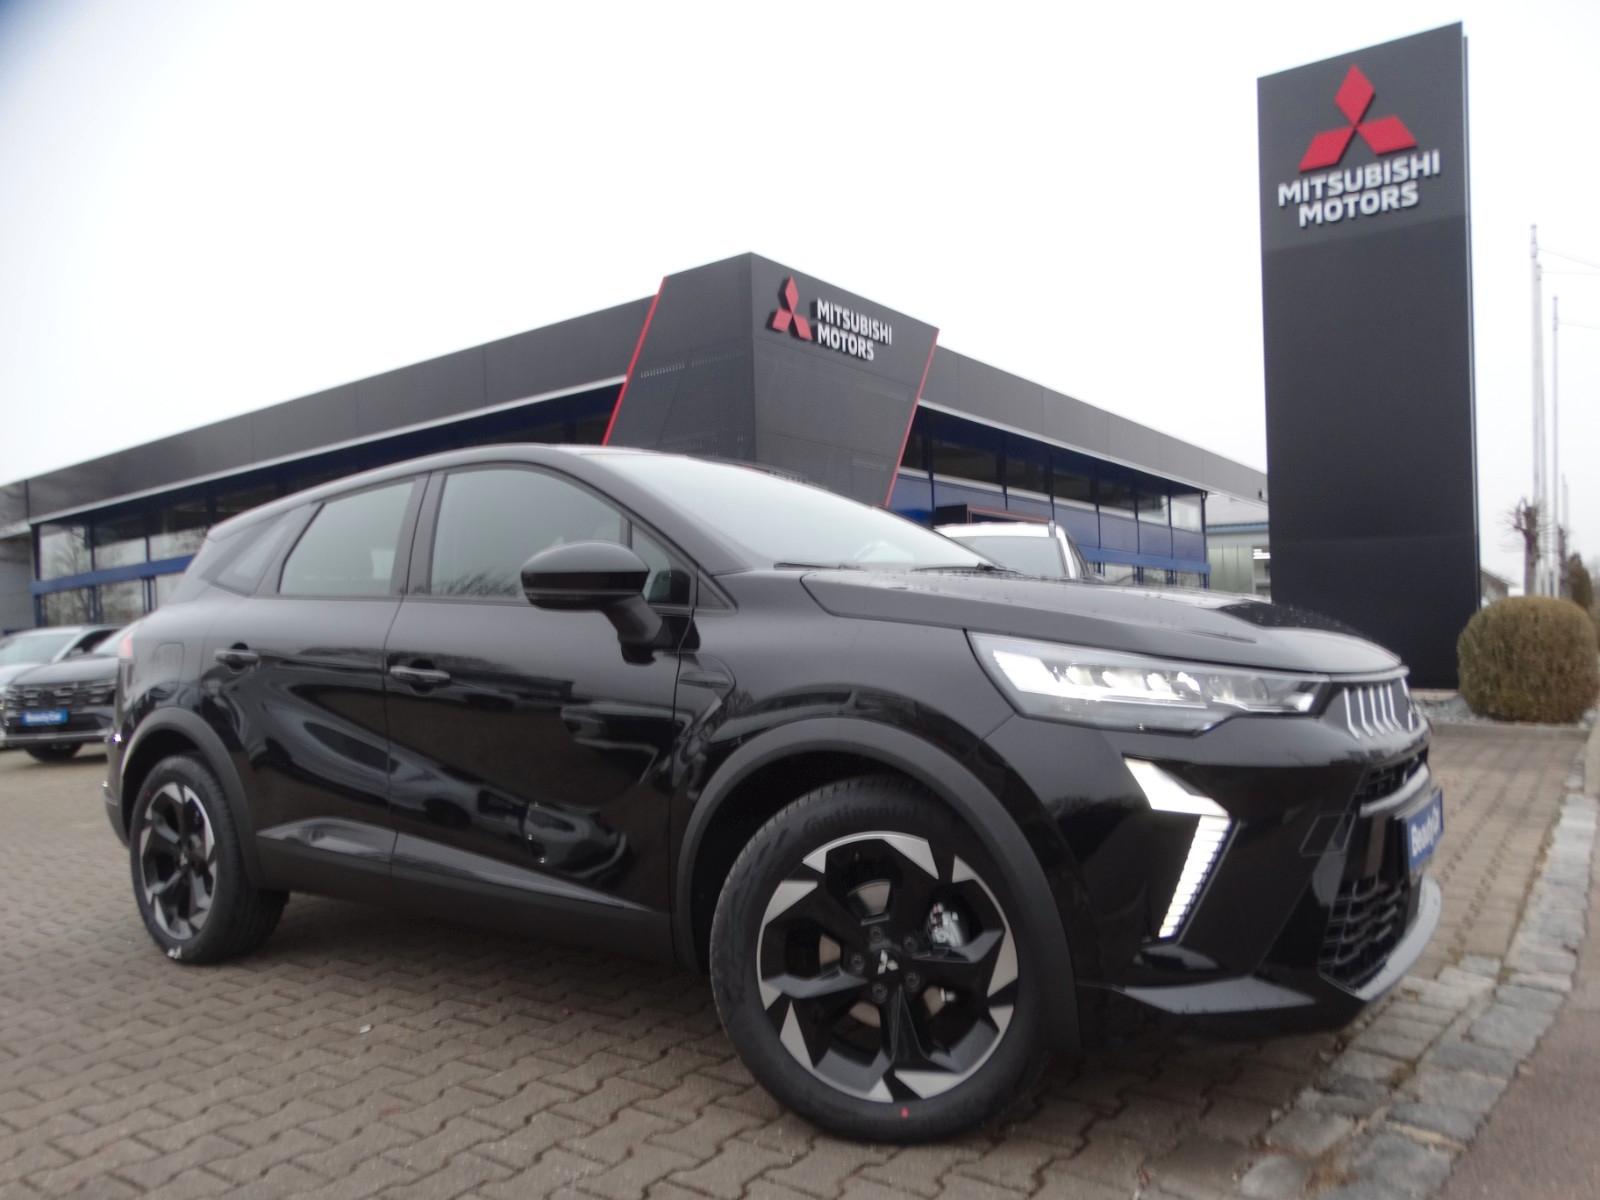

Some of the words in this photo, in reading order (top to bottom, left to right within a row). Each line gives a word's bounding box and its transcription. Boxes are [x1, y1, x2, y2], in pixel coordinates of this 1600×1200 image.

[1278, 150, 1440, 207] MITSUBISHI
[1300, 181, 1419, 227] MOTORS
[816, 298, 892, 345] MITSUBISHI
[817, 323, 874, 361] MOTORS
